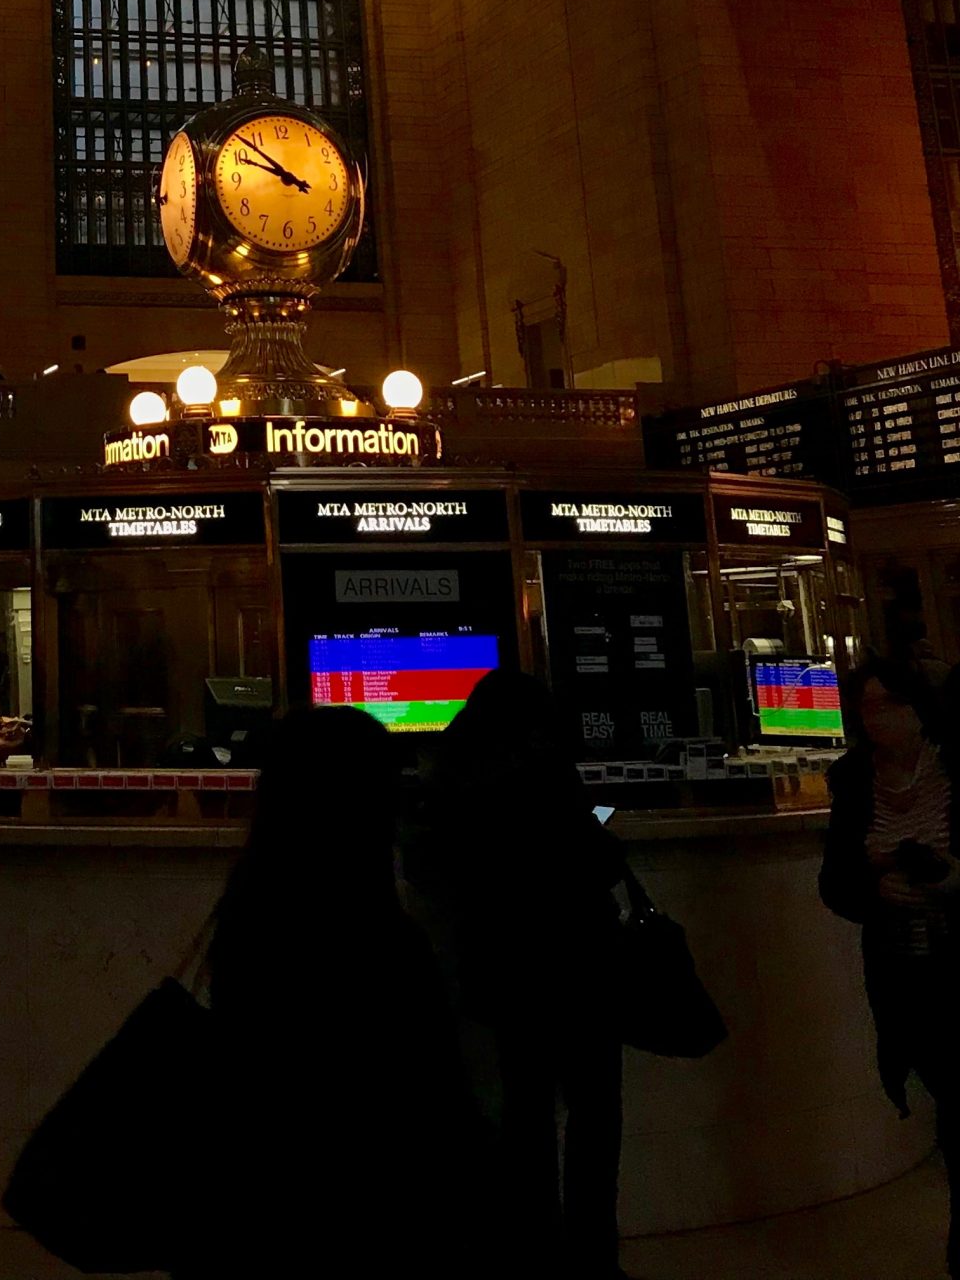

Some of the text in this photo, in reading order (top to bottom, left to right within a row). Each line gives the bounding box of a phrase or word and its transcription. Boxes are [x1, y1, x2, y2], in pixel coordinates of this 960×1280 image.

[251, 131, 264, 148] 11
[273, 124, 289, 140] 12
[304, 132, 312, 147] 1
[233, 148, 248, 166] 10
[321, 147, 332, 164] 2
[179, 180, 187, 199] 3
[231, 171, 242, 192] 9
[328, 173, 338, 192] 3
[240, 197, 250, 217] 8
[324, 198, 335, 217] 4
[259, 214, 269, 232] 7
[282, 220, 294, 240] 6
[305, 216, 317, 234] 5
[877, 365, 897, 381] NEW
[898, 358, 929, 376] HAVEN
[929, 353, 951, 369] LINE
[701, 388, 798, 419] NEW HAVEN LINE DEPARTURES
[210, 430, 232, 448] MTA
[265, 420, 420, 456] Information
[80, 504, 226, 522] MTA METRO-NORTH
[317, 501, 468, 517] MTA METRO-NORTH
[551, 502, 673, 518] MTA METRO-NORTH
[730, 507, 803, 524] MTA METRO-NORTH
[108, 520, 198, 537] TIMETABLES
[356, 516, 432, 532] ARRIVALS
[576, 518, 652, 533] TIMETABLES
[746, 522, 791, 537] TIMETABLES
[343, 577, 453, 596] ARRIVALS
[582, 711, 615, 726] REAL
[640, 711, 672, 725] REAL
[583, 725, 616, 739] EASY
[642, 725, 674, 738] TIME
